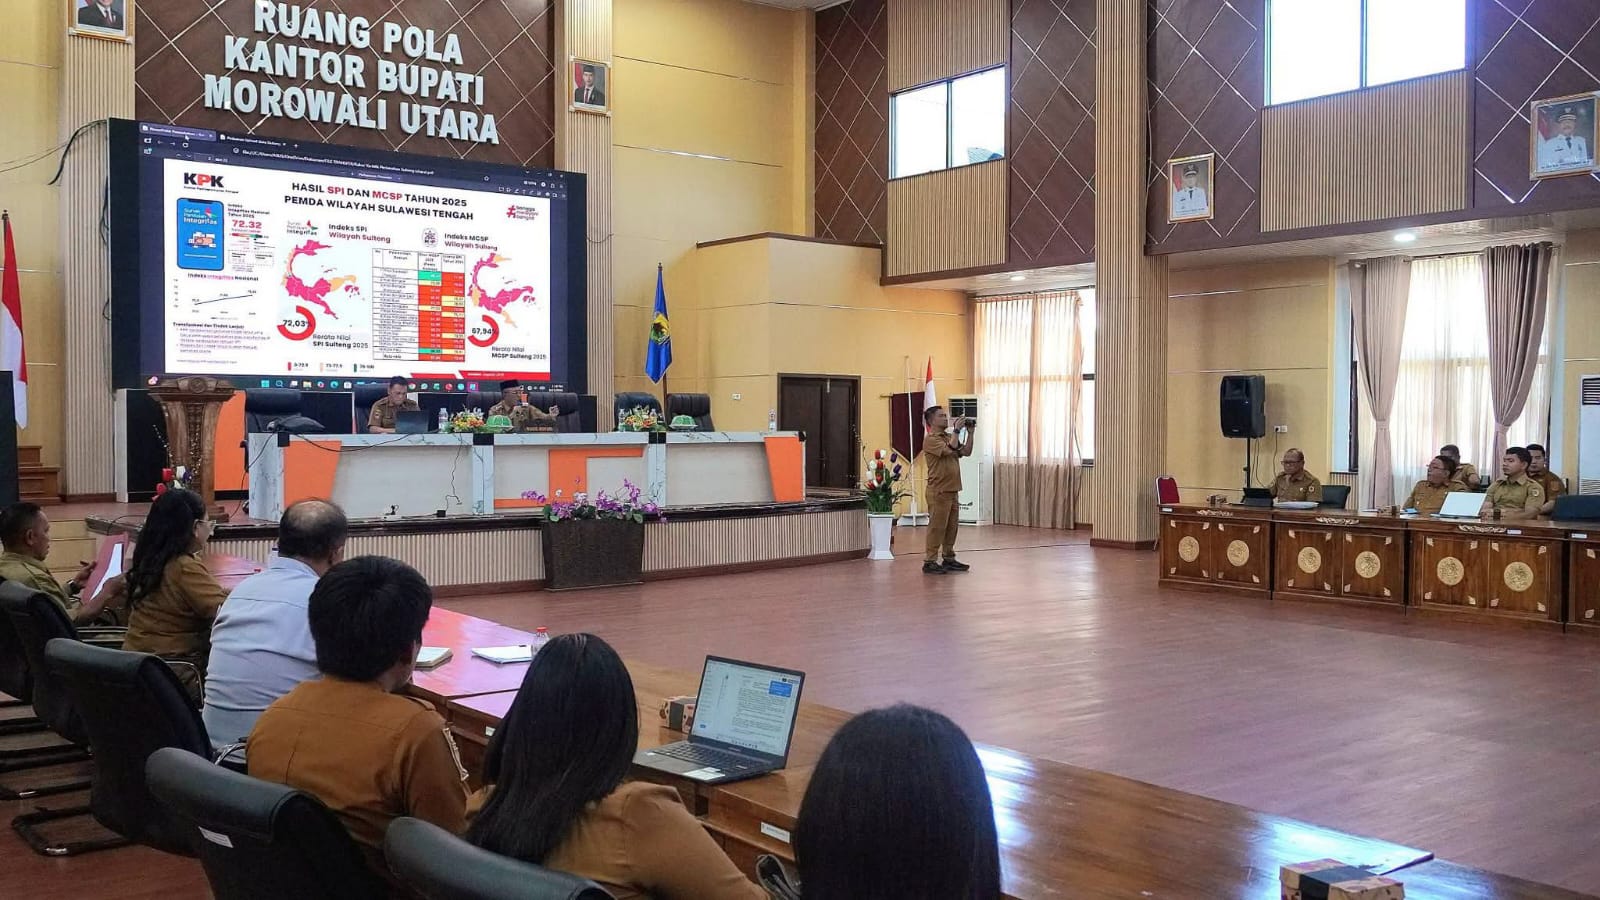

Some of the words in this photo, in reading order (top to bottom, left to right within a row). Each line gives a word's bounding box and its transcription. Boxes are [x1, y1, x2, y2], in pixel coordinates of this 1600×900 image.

[254, 0, 370, 49] RUANG
[383, 22, 463, 65] POLA
[224, 35, 365, 88] KANTOR
[377, 62, 484, 106] BUPATI
[204, 74, 387, 130] MOROWALI
[400, 102, 499, 145] UTARA
[183, 172, 224, 188] KPK
[292, 182, 325, 193] HASIL
[327, 186, 345, 195] SPI
[347, 188, 370, 198] DAN
[372, 190, 402, 200] MCSP
[405, 193, 440, 205] TAHUN
[441, 197, 467, 207] 2025
[284, 195, 324, 206] PEMDA
[327, 199, 376, 212] WILAYAH
[378, 204, 431, 217] SULAWESI
[432, 209, 474, 220] TENGAH
[232, 219, 262, 229] 72.32
[329, 224, 354, 232] Indeks
[329, 232, 360, 241] Wilayah
[445, 233, 468, 241] Indeks
[445, 241, 474, 249] Wilayah
[325, 341, 351, 349] Sulteng
